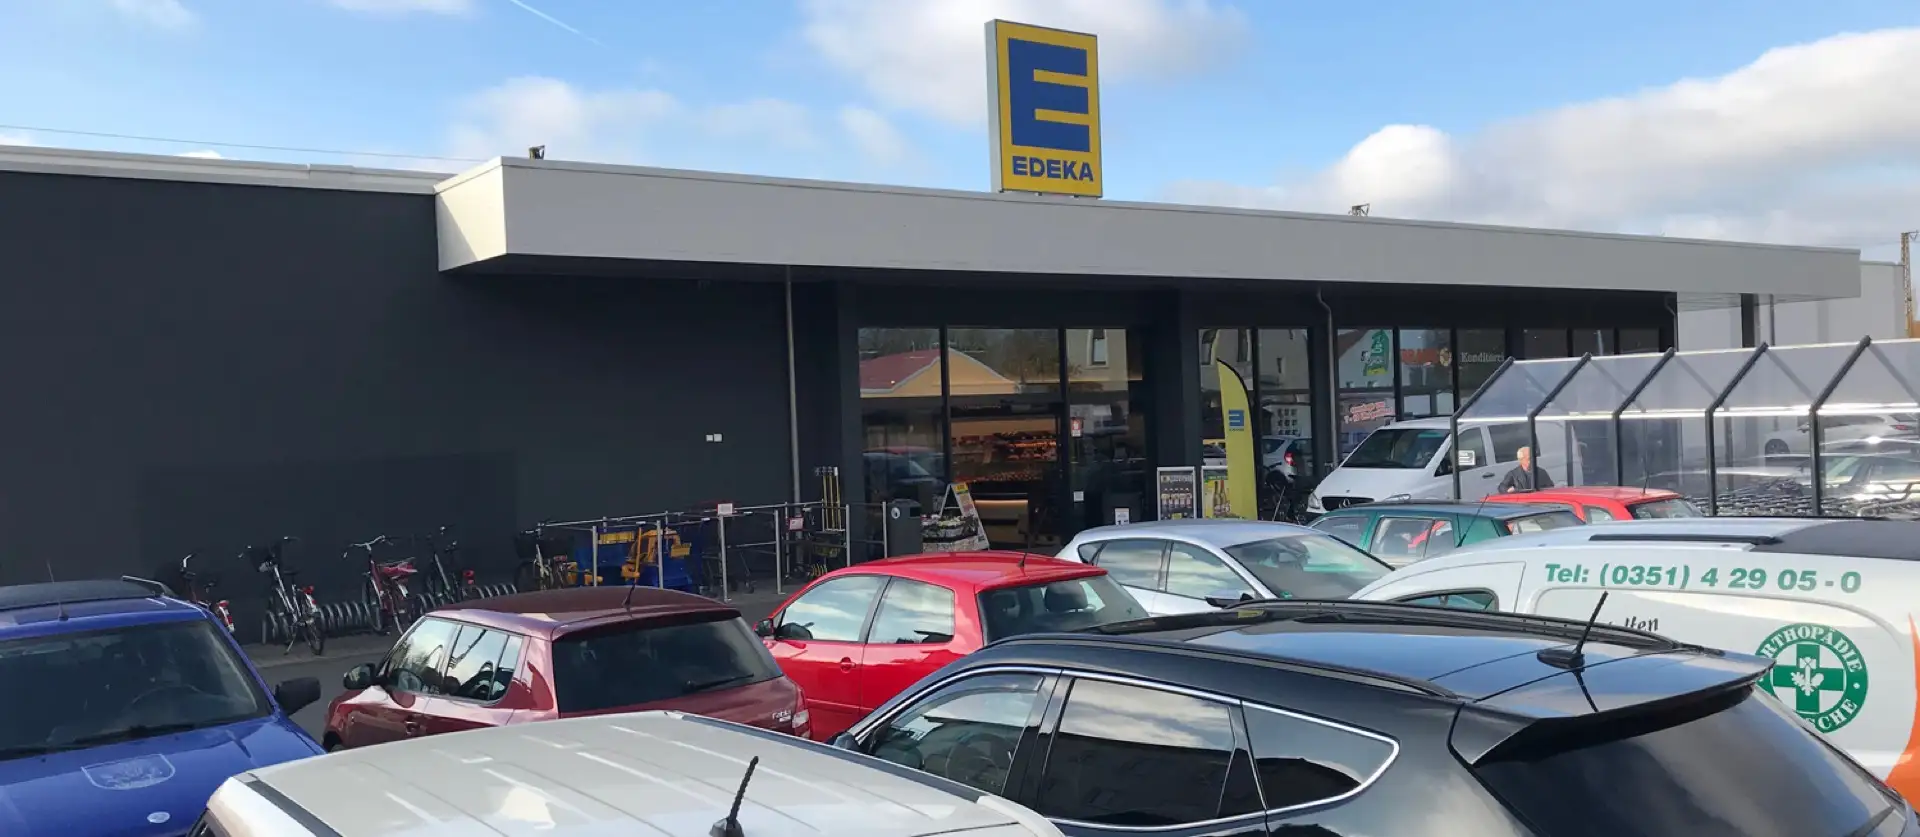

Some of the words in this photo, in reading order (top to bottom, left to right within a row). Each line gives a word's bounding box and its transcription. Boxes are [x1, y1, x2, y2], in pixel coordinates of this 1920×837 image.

[1008, 38, 1091, 152] E
[1012, 155, 1094, 181] EDEKA
[1545, 563, 1589, 583] Tel:
[1600, 563, 1690, 589] (0351)
[1700, 567, 1718, 587] 4
[1728, 567, 1767, 589] 29
[1758, 625, 1863, 673] RTHOPÄDIE
